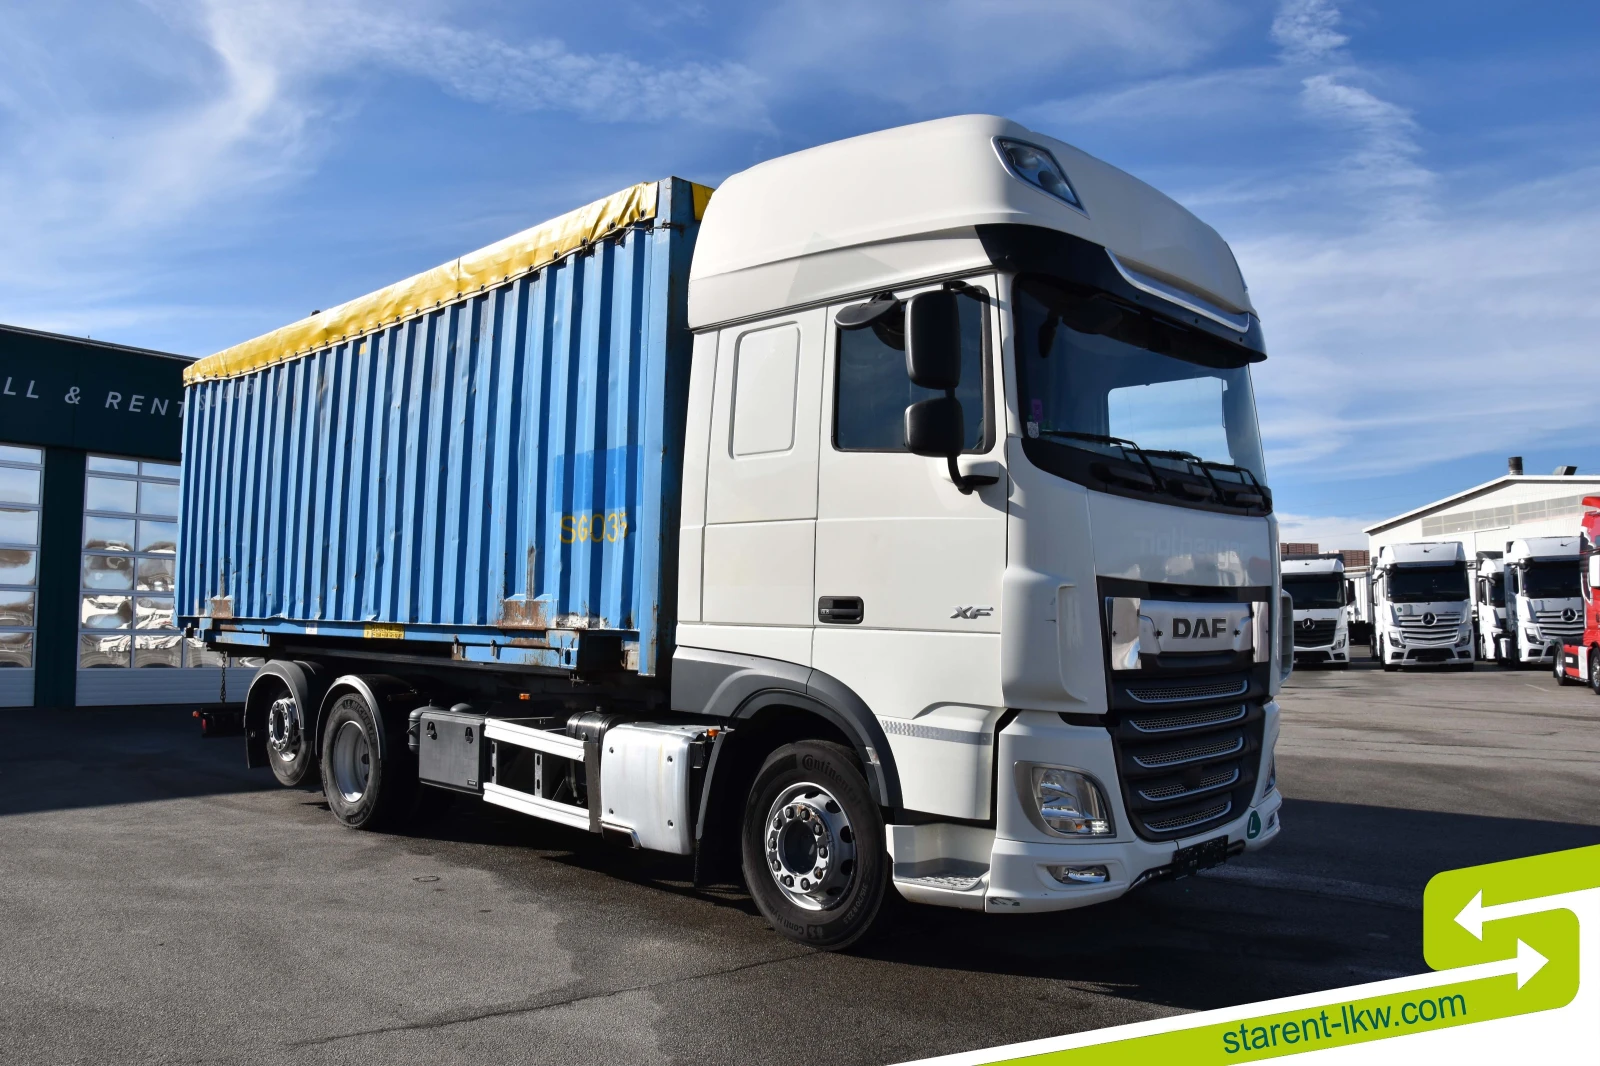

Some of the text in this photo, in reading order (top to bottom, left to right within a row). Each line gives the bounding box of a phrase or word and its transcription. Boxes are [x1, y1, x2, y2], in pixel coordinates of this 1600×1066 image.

[64, 386, 82, 405] &
[949, 605, 994, 620] XF
[1172, 617, 1227, 640] DAF
[1249, 816, 1256, 834] L
